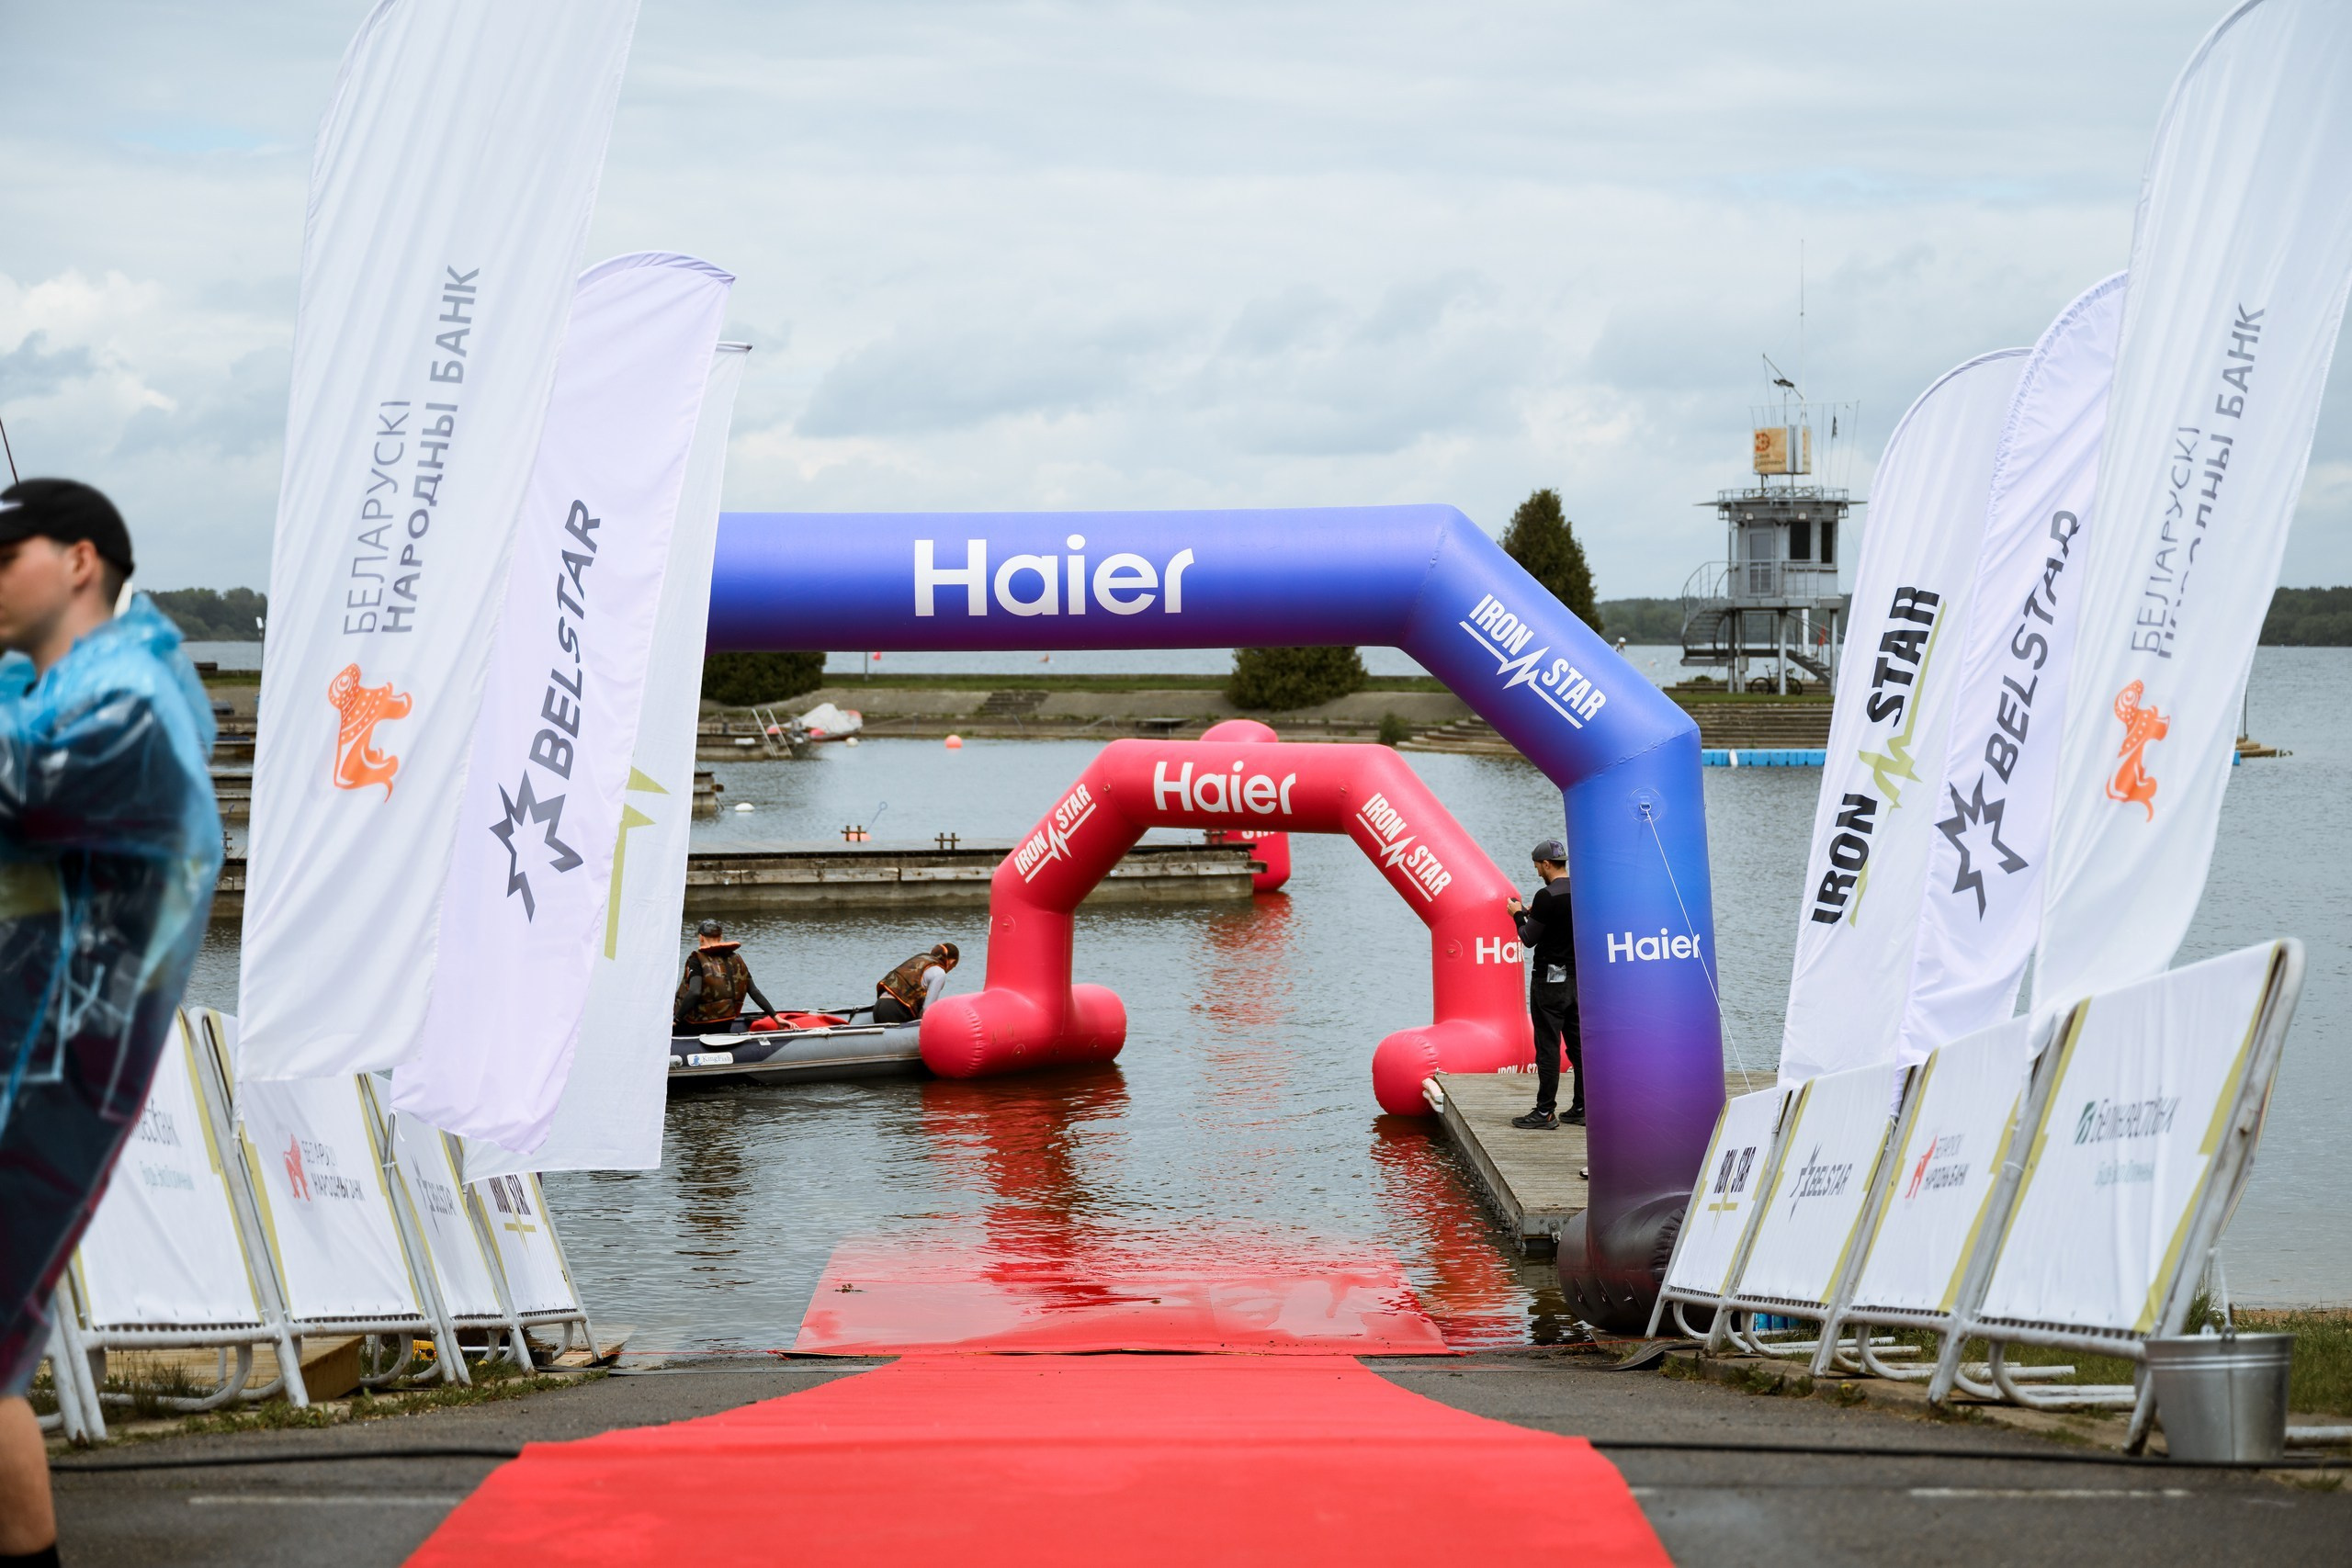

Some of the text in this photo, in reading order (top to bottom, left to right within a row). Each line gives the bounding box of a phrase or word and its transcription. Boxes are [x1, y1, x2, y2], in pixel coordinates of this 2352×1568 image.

[2215, 302, 2265, 419] БАНК
[381, 265, 480, 633] НАРОДНЫ БАНК
[344, 400, 411, 635] БЕЛАРУСКІ
[913, 534, 1195, 617] Haier
[2131, 426, 2200, 654] БЕЛАРУСКІ
[528, 499, 601, 781] BELSTAR
[1468, 592, 1607, 722] IRON STAR
[1984, 510, 2081, 785] BELSTAR
[1153, 761, 1296, 815] Haier
[1811, 586, 1940, 925] IRON STAR
[1014, 784, 1092, 876] IRON STAR
[1362, 793, 1453, 897] IRON STAR
[1476, 934, 1524, 964] Hai
[1607, 928, 1701, 964] Haier
[1806, 1163, 1853, 1197] BELSTAR
